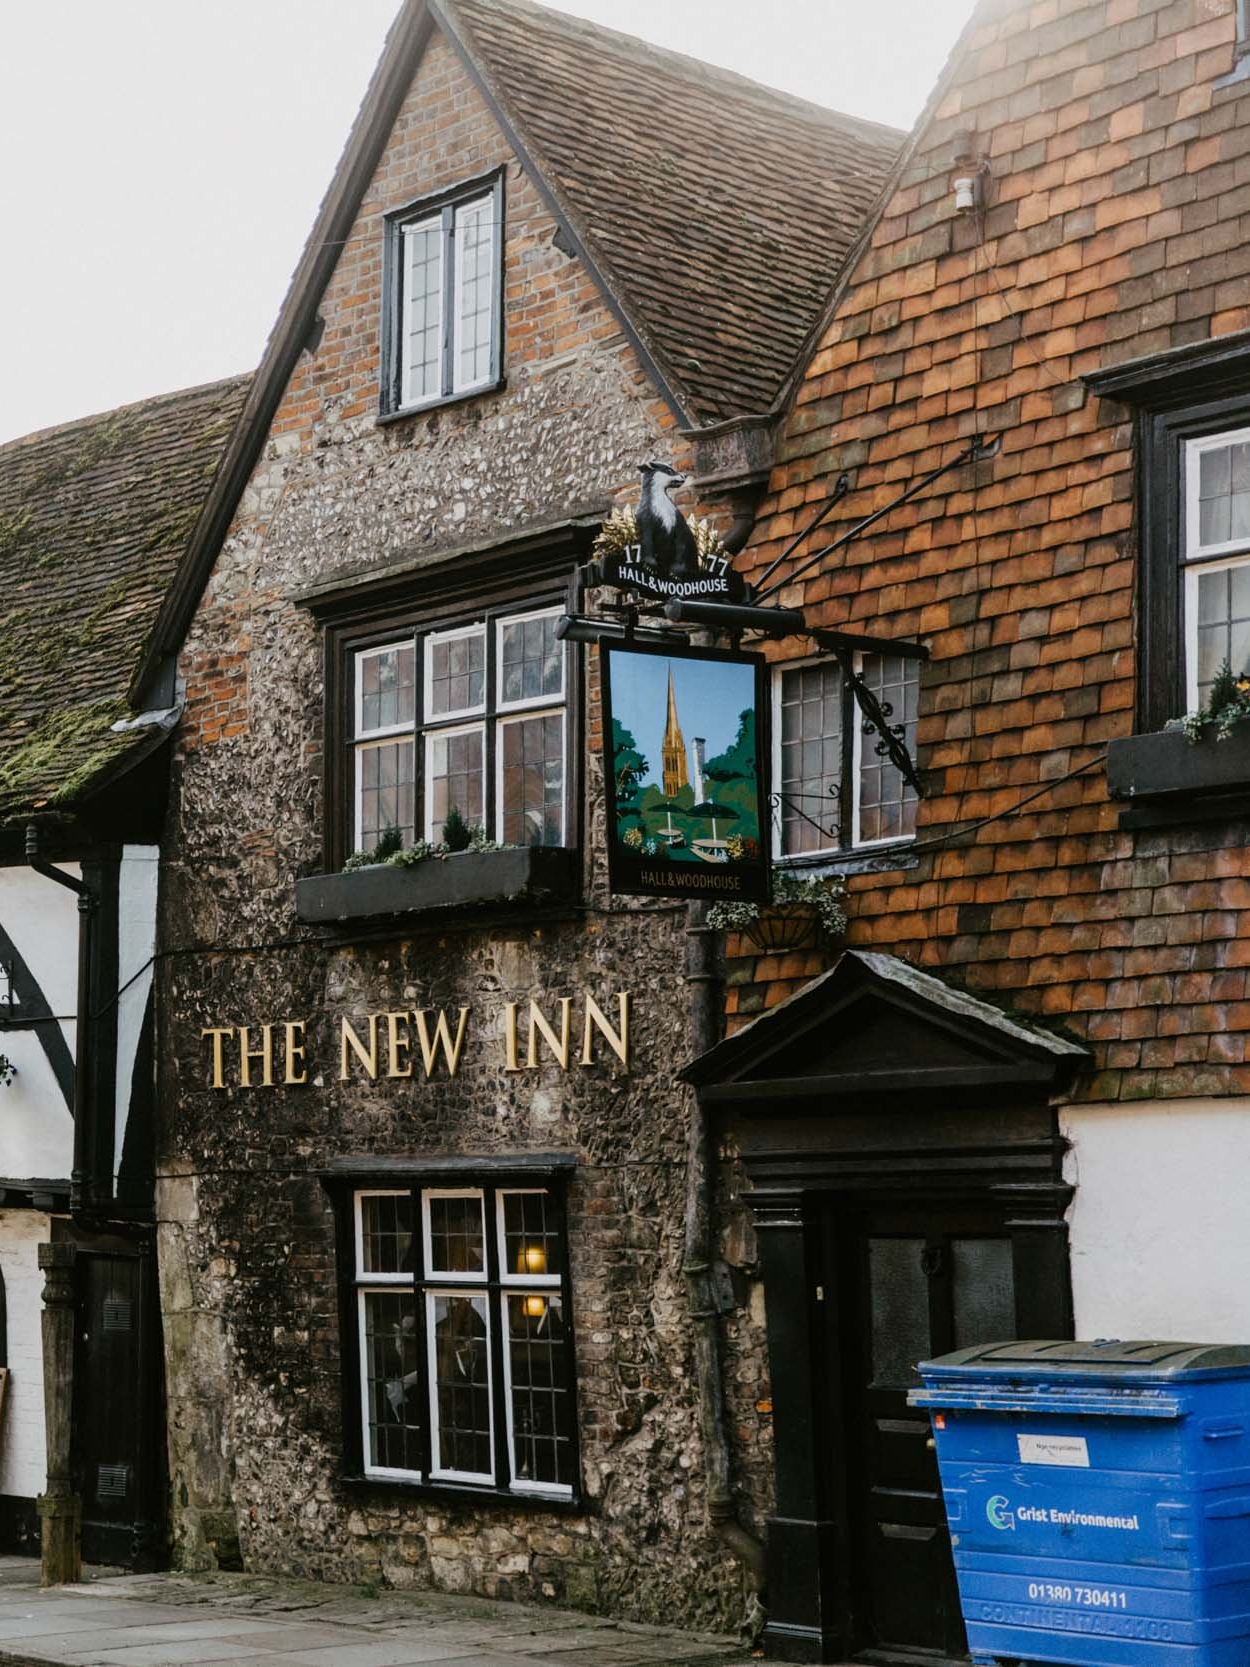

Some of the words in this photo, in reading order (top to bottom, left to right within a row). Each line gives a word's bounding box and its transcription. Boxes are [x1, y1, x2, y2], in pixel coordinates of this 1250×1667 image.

[623, 544, 641, 564] 17
[706, 554, 729, 577] 77
[201, 1020, 307, 1089] THE
[340, 1006, 471, 1081] NEW
[503, 991, 630, 1071] INN
[1017, 1506, 1048, 1522] Grist
[1049, 1509, 1140, 1531] Environmental
[1028, 1583, 1071, 1602] 01380
[1074, 1586, 1127, 1608] 730411
